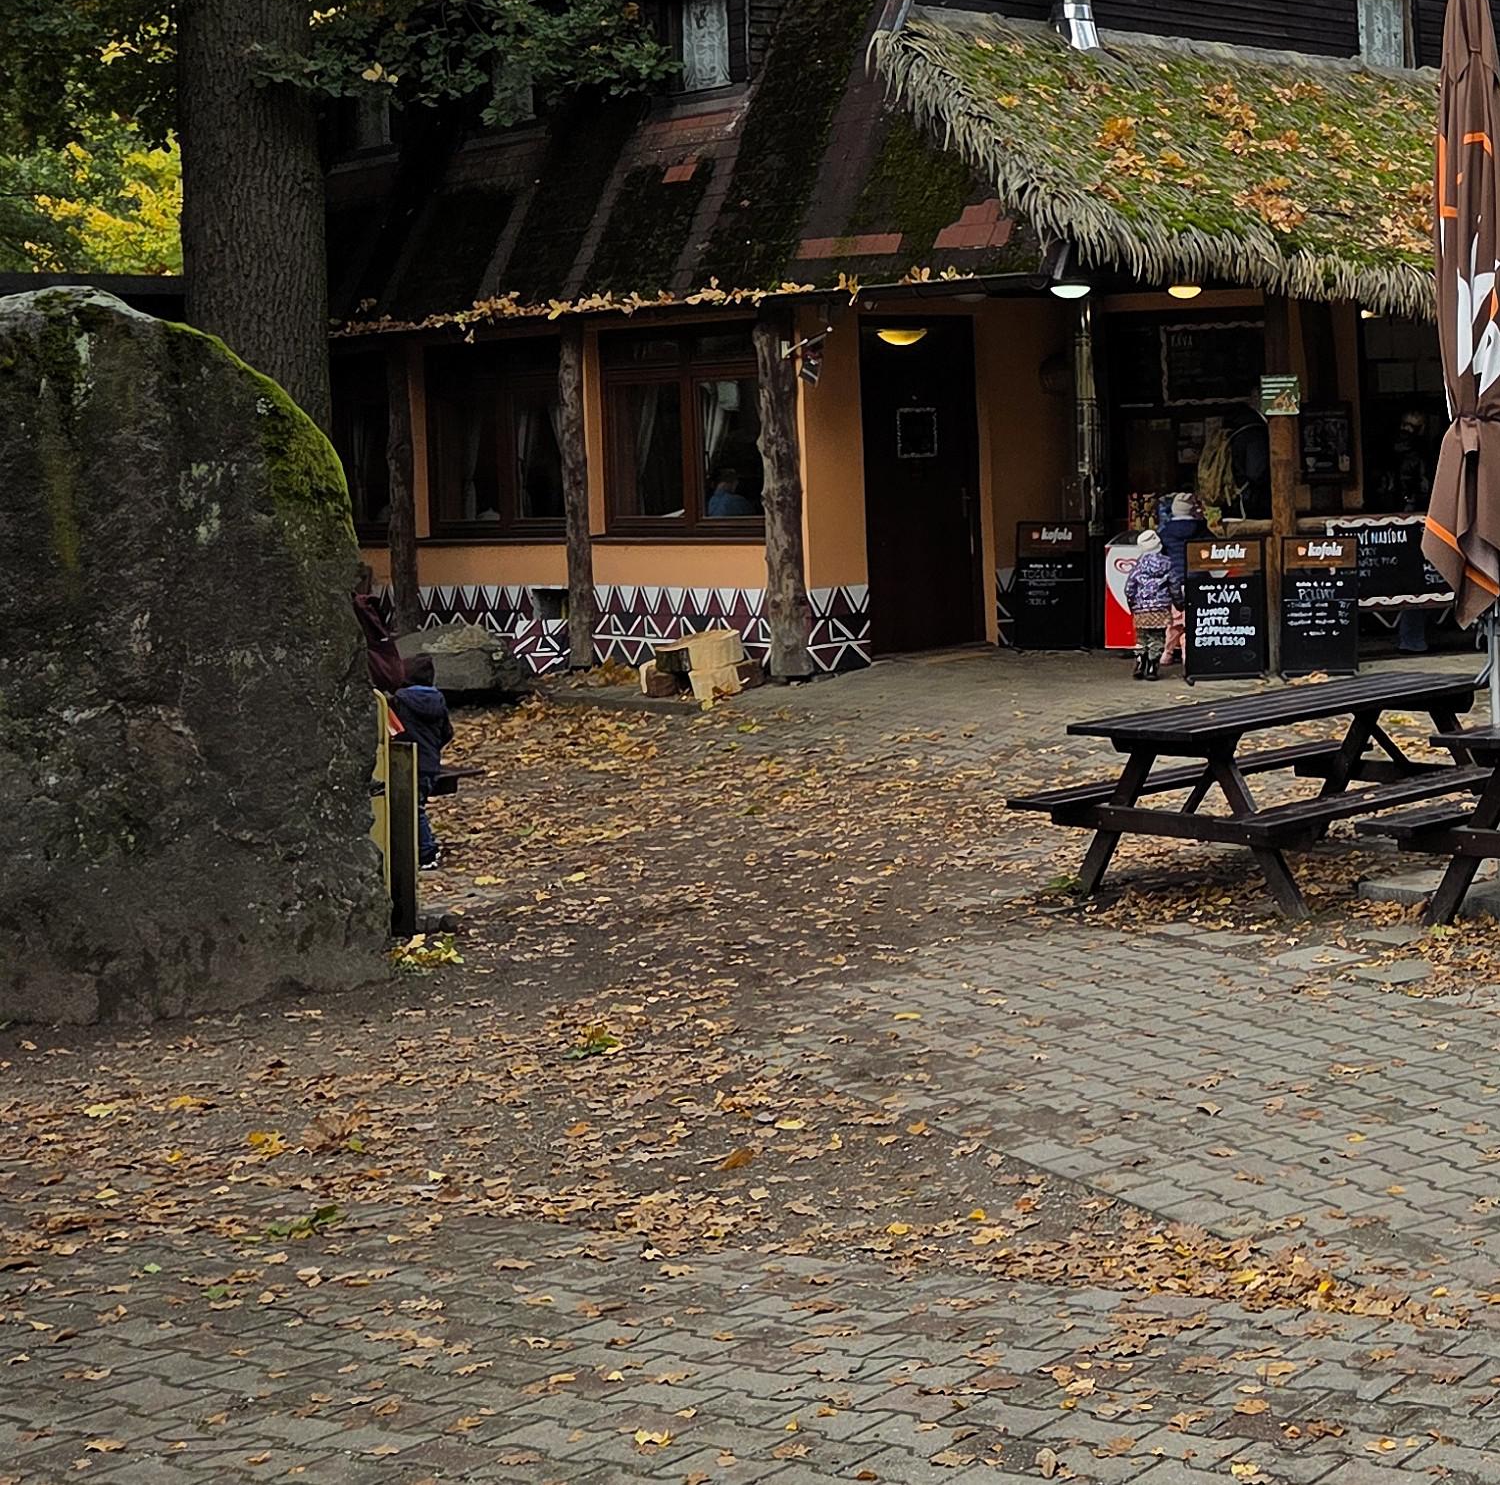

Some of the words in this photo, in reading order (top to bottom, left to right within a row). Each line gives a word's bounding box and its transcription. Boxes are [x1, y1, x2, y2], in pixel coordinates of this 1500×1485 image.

[1041, 527, 1073, 544] kofola
[1210, 543, 1248, 563] kofola
[1307, 541, 1344, 560] kofola
[1207, 586, 1242, 604] KÁVA
[1196, 607, 1230, 617] LUNGO
[1196, 616, 1230, 627] LATTE
[1194, 636, 1246, 647] ESPRESSO
